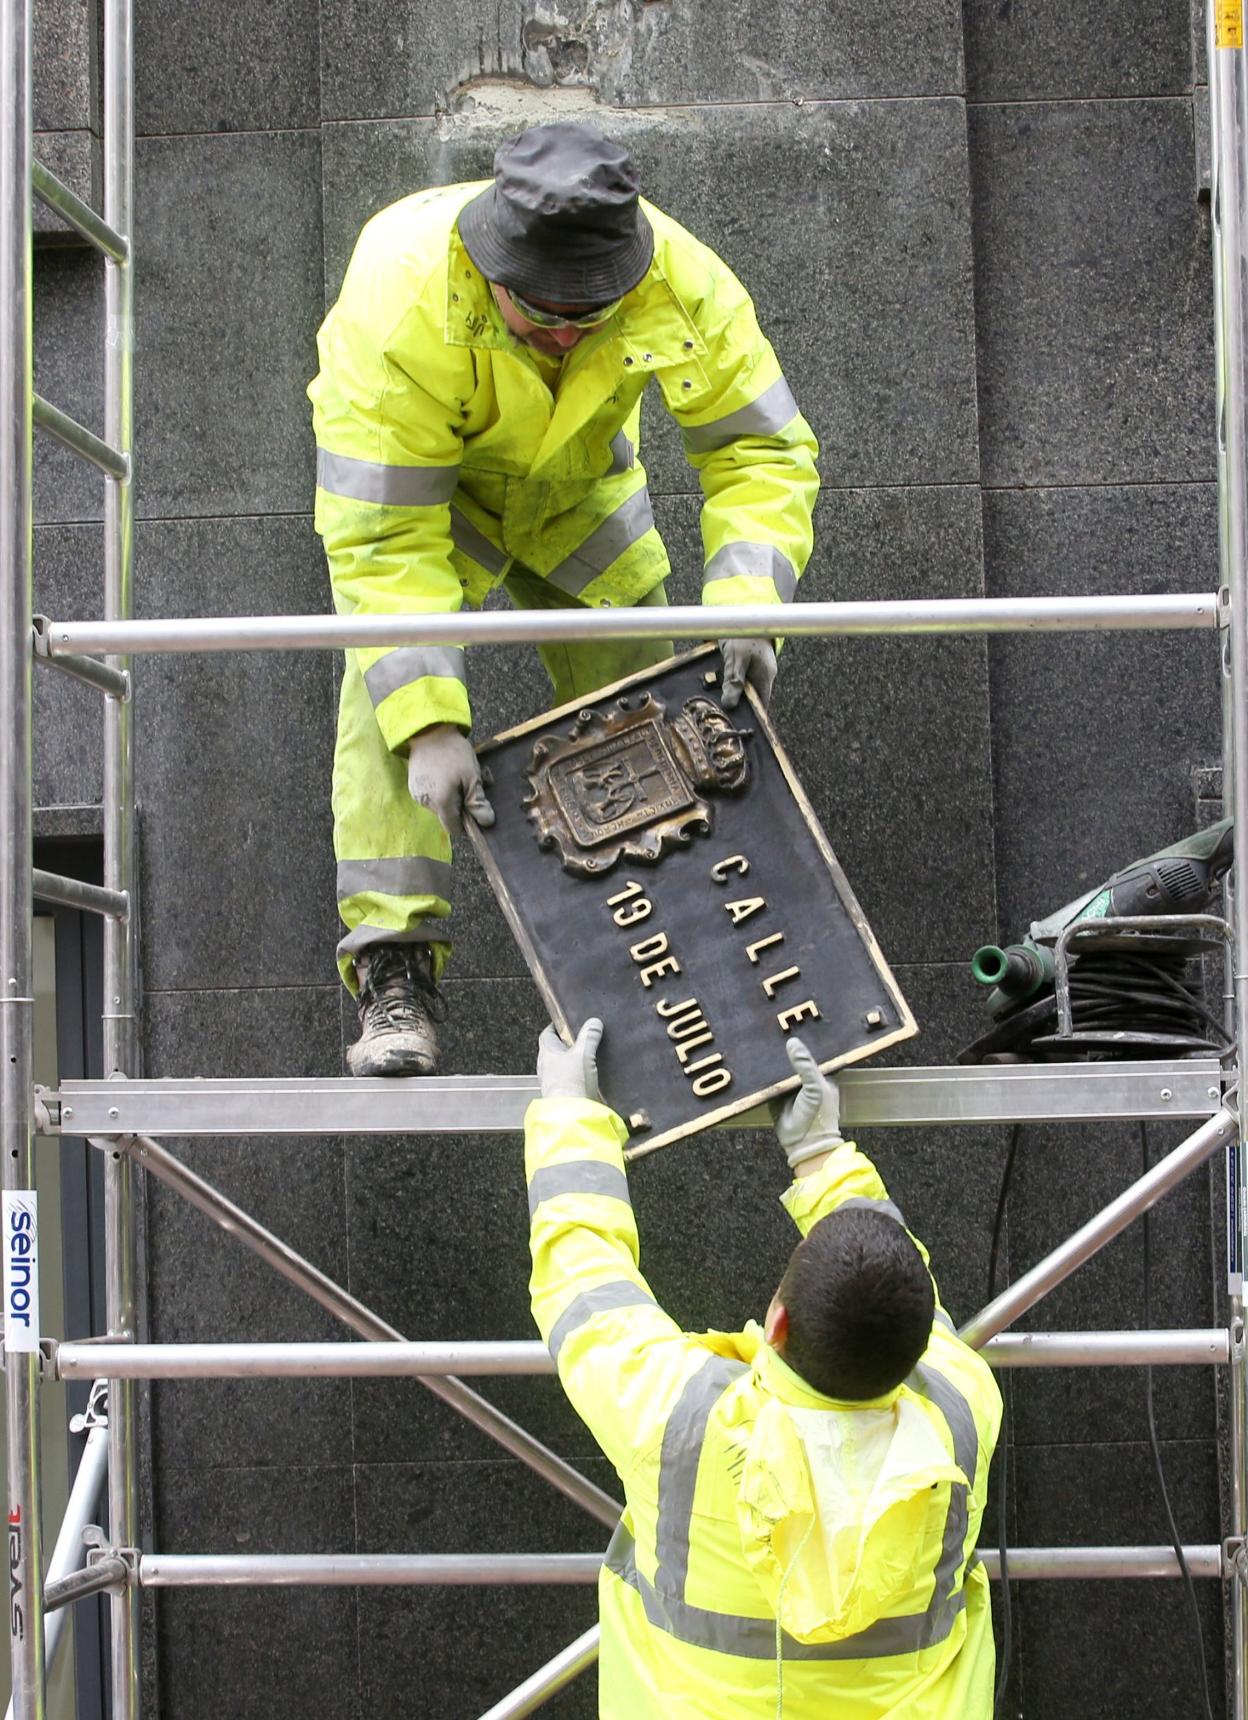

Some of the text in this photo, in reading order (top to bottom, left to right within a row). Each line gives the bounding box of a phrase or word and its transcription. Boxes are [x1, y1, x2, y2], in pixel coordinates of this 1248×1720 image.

[606, 881, 732, 1097] 19 DE JULIO
[710, 853, 820, 1030] CALLE
[10, 1211, 36, 1328] seinor
